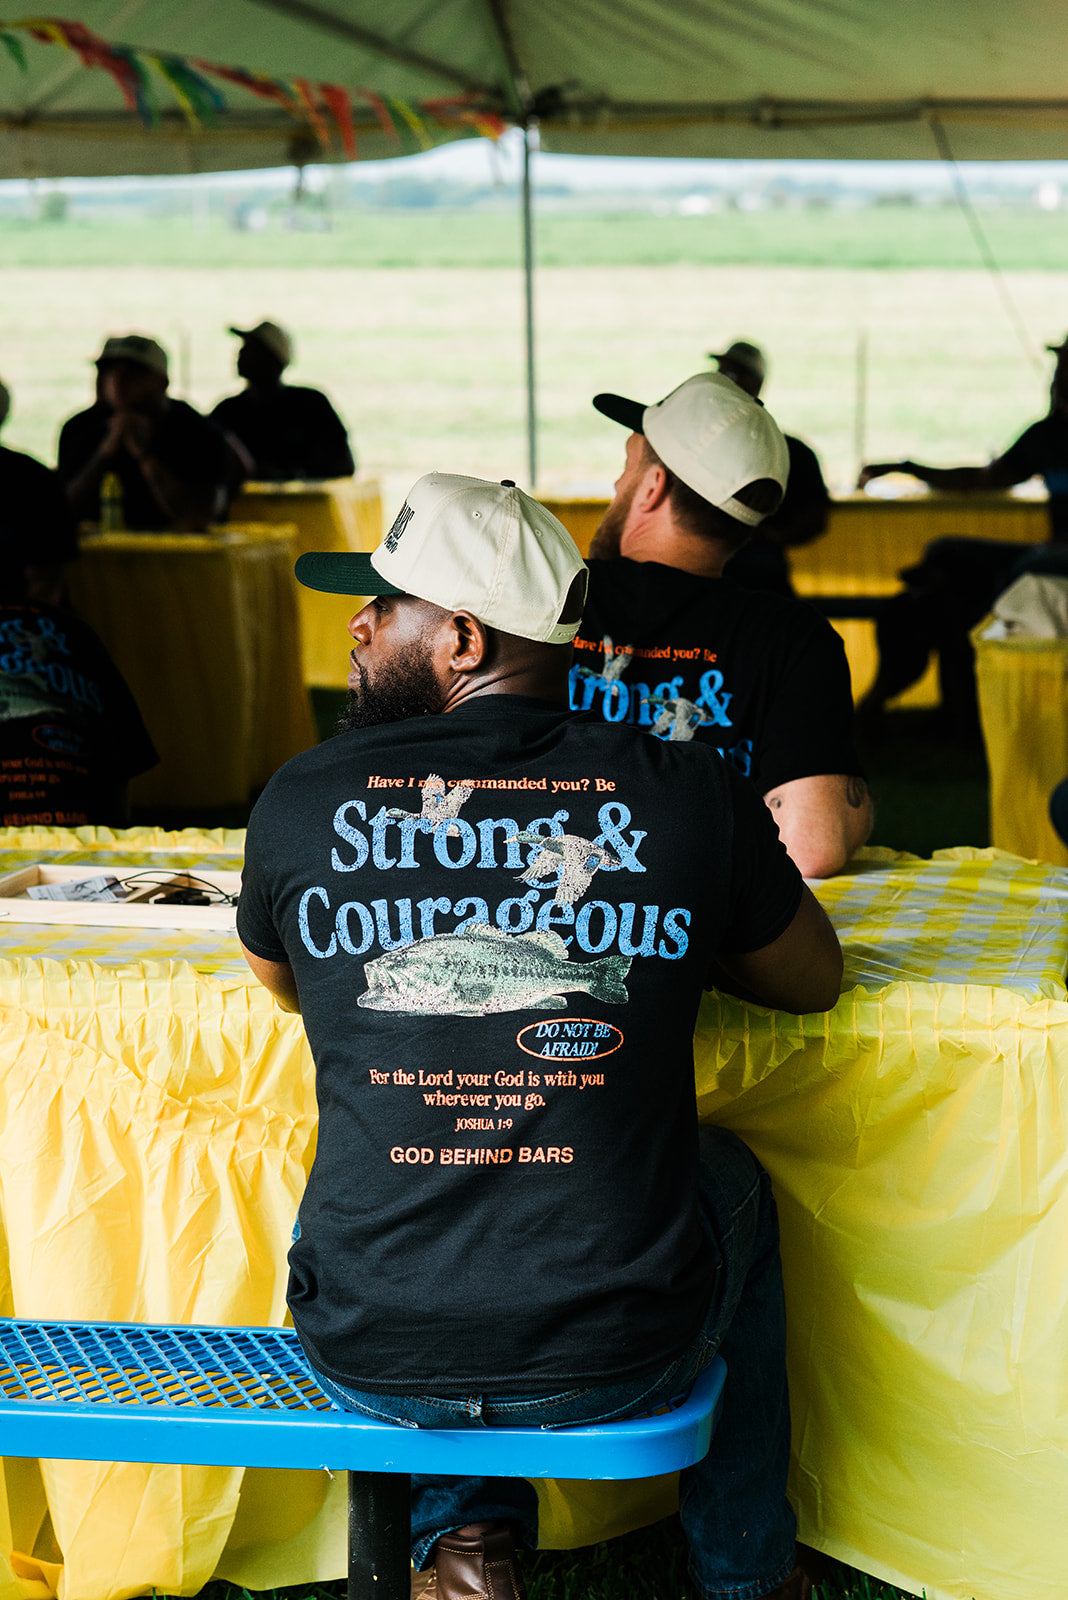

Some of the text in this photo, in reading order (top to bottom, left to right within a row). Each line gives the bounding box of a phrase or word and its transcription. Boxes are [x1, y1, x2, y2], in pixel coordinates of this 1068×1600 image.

[673, 648, 701, 662] you?
[703, 648, 718, 663] Be
[698, 670, 733, 727] &
[366, 775, 404, 789] Have
[408, 778, 415, 788] I
[551, 778, 589, 793] you?
[595, 779, 616, 793] Be
[331, 799, 648, 889] Strong &
[297, 886, 692, 960] Courageous
[535, 1023, 613, 1038] DO NOT BE
[539, 1041, 599, 1056] AFRAID!
[369, 1068, 605, 1090] For the Lord your God is with you
[423, 1089, 546, 1111] wherever you go.
[454, 1117, 513, 1132] JOSHUA 1:9
[390, 1146, 574, 1165] GOD BEHIND BARS
